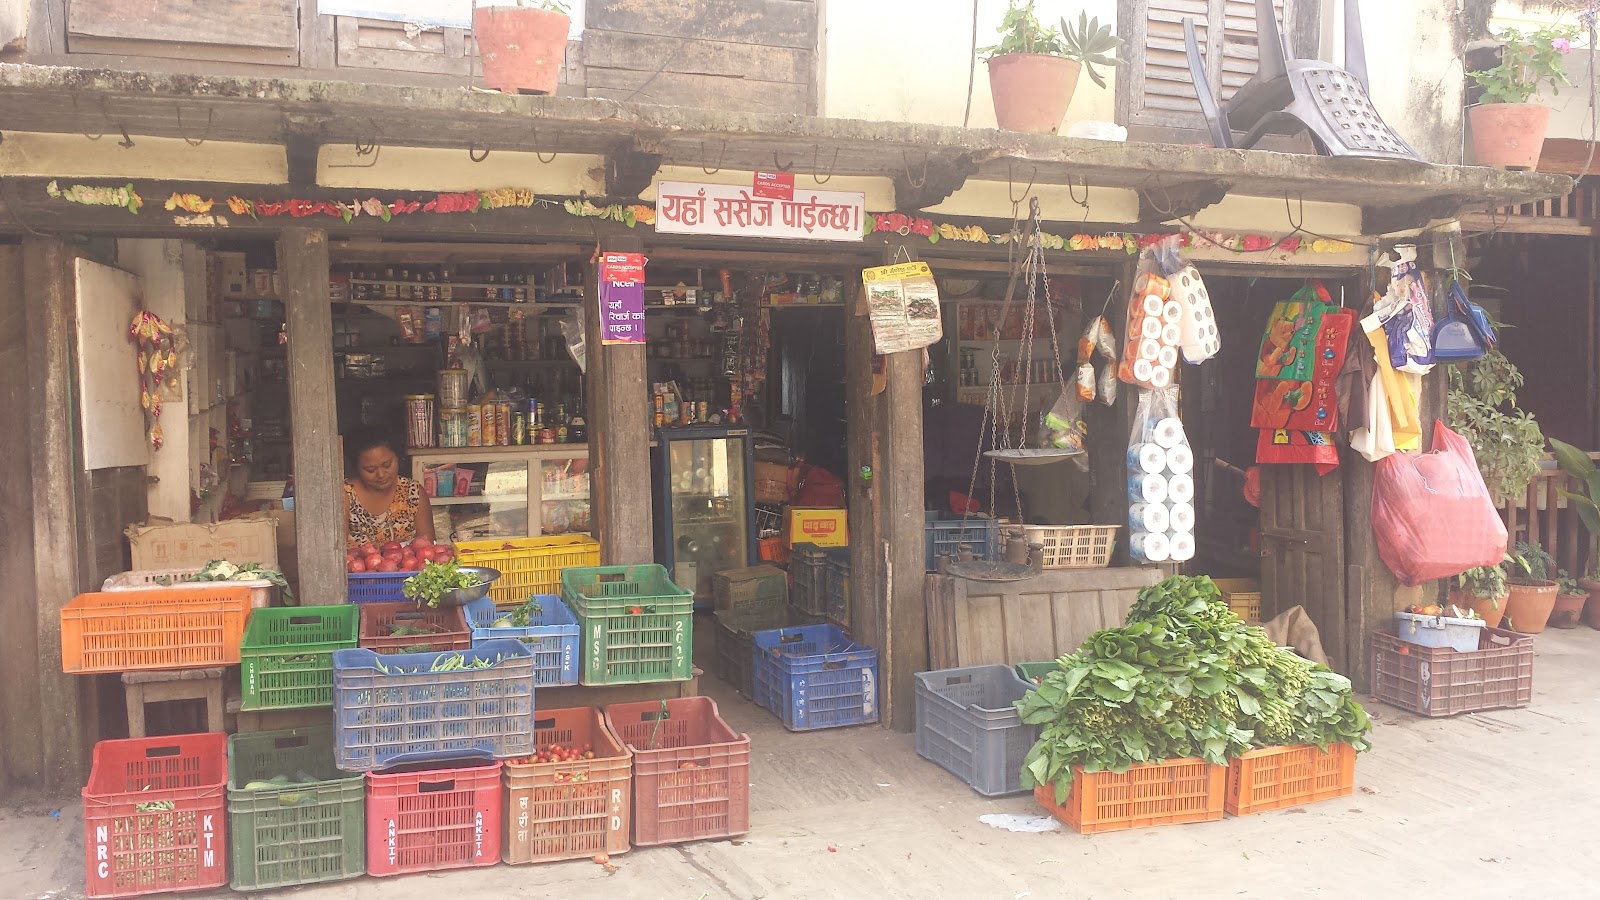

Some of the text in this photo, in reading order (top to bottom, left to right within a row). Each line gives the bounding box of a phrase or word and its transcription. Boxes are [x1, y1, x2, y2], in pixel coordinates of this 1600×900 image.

[662, 187, 859, 233] यहाँ ससेज पाईन्छ।
[675, 620, 684, 668] 2017
[96, 825, 109, 879] NRC
[203, 814, 214, 868] KTM
[388, 819, 396, 866] ANKIT
[475, 811, 483, 857] ANKITA
